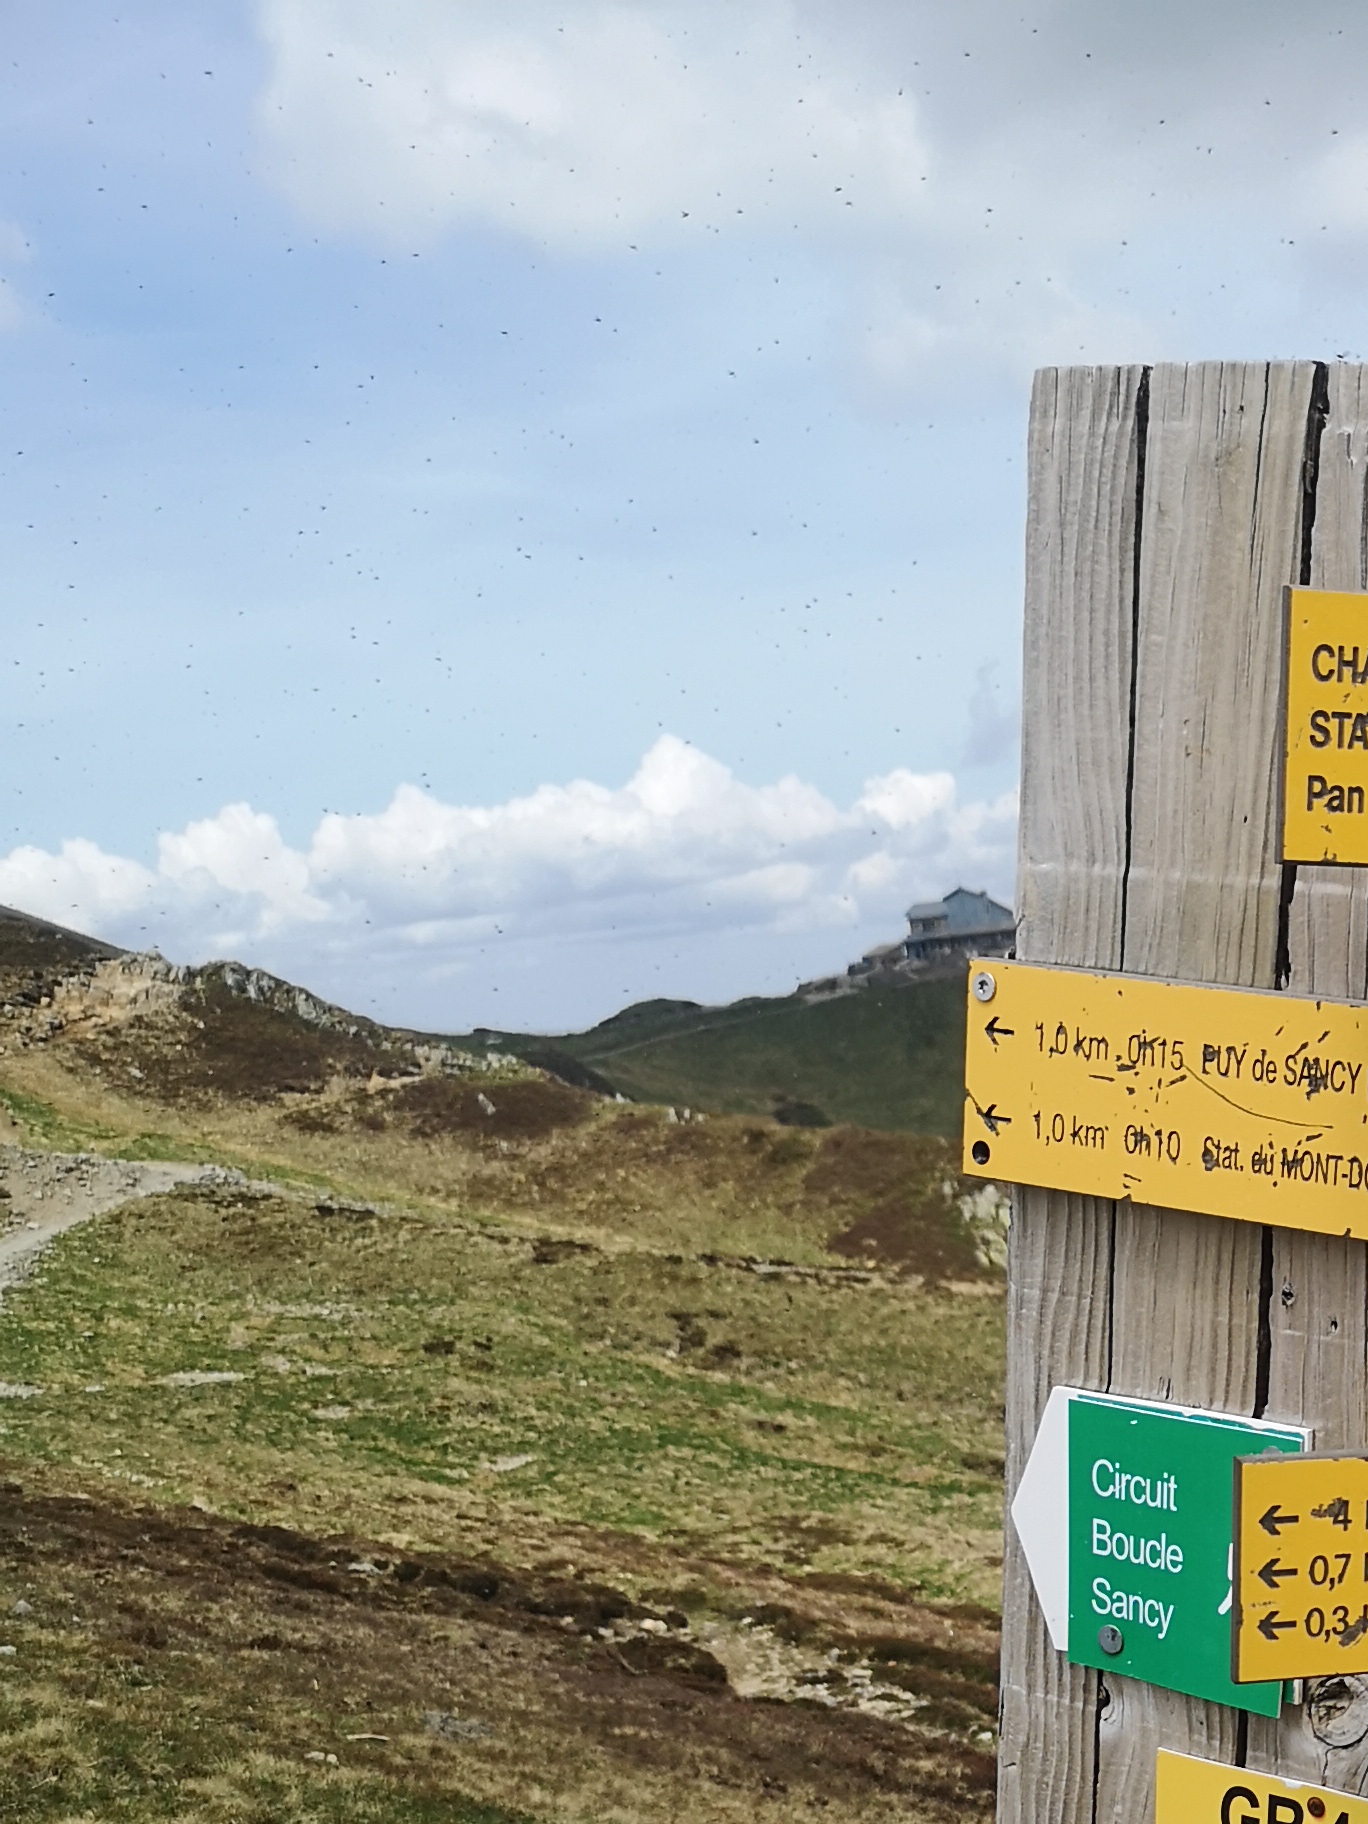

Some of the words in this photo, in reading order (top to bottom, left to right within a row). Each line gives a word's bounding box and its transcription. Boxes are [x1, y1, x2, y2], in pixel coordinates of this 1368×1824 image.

[1307, 774, 1365, 815] Pan
[1035, 1021, 1069, 1058] 1,0
[1073, 1026, 1110, 1062] km
[1202, 1043, 1249, 1079] PUY
[1252, 1049, 1278, 1085] de
[1283, 1054, 1363, 1096] SANCY
[1033, 1110, 1066, 1146] 1,0
[1071, 1115, 1106, 1150] km
[1124, 1124, 1182, 1163] 0h10
[1202, 1136, 1245, 1171] Stat.
[1251, 1143, 1275, 1176] du
[1091, 1459, 1178, 1512] Circuit
[1091, 1518, 1184, 1574] Boucle
[1308, 1553, 1352, 1591] 0,7
[1091, 1577, 1174, 1639] Sancy
[1304, 1605, 1350, 1642] 0,3
